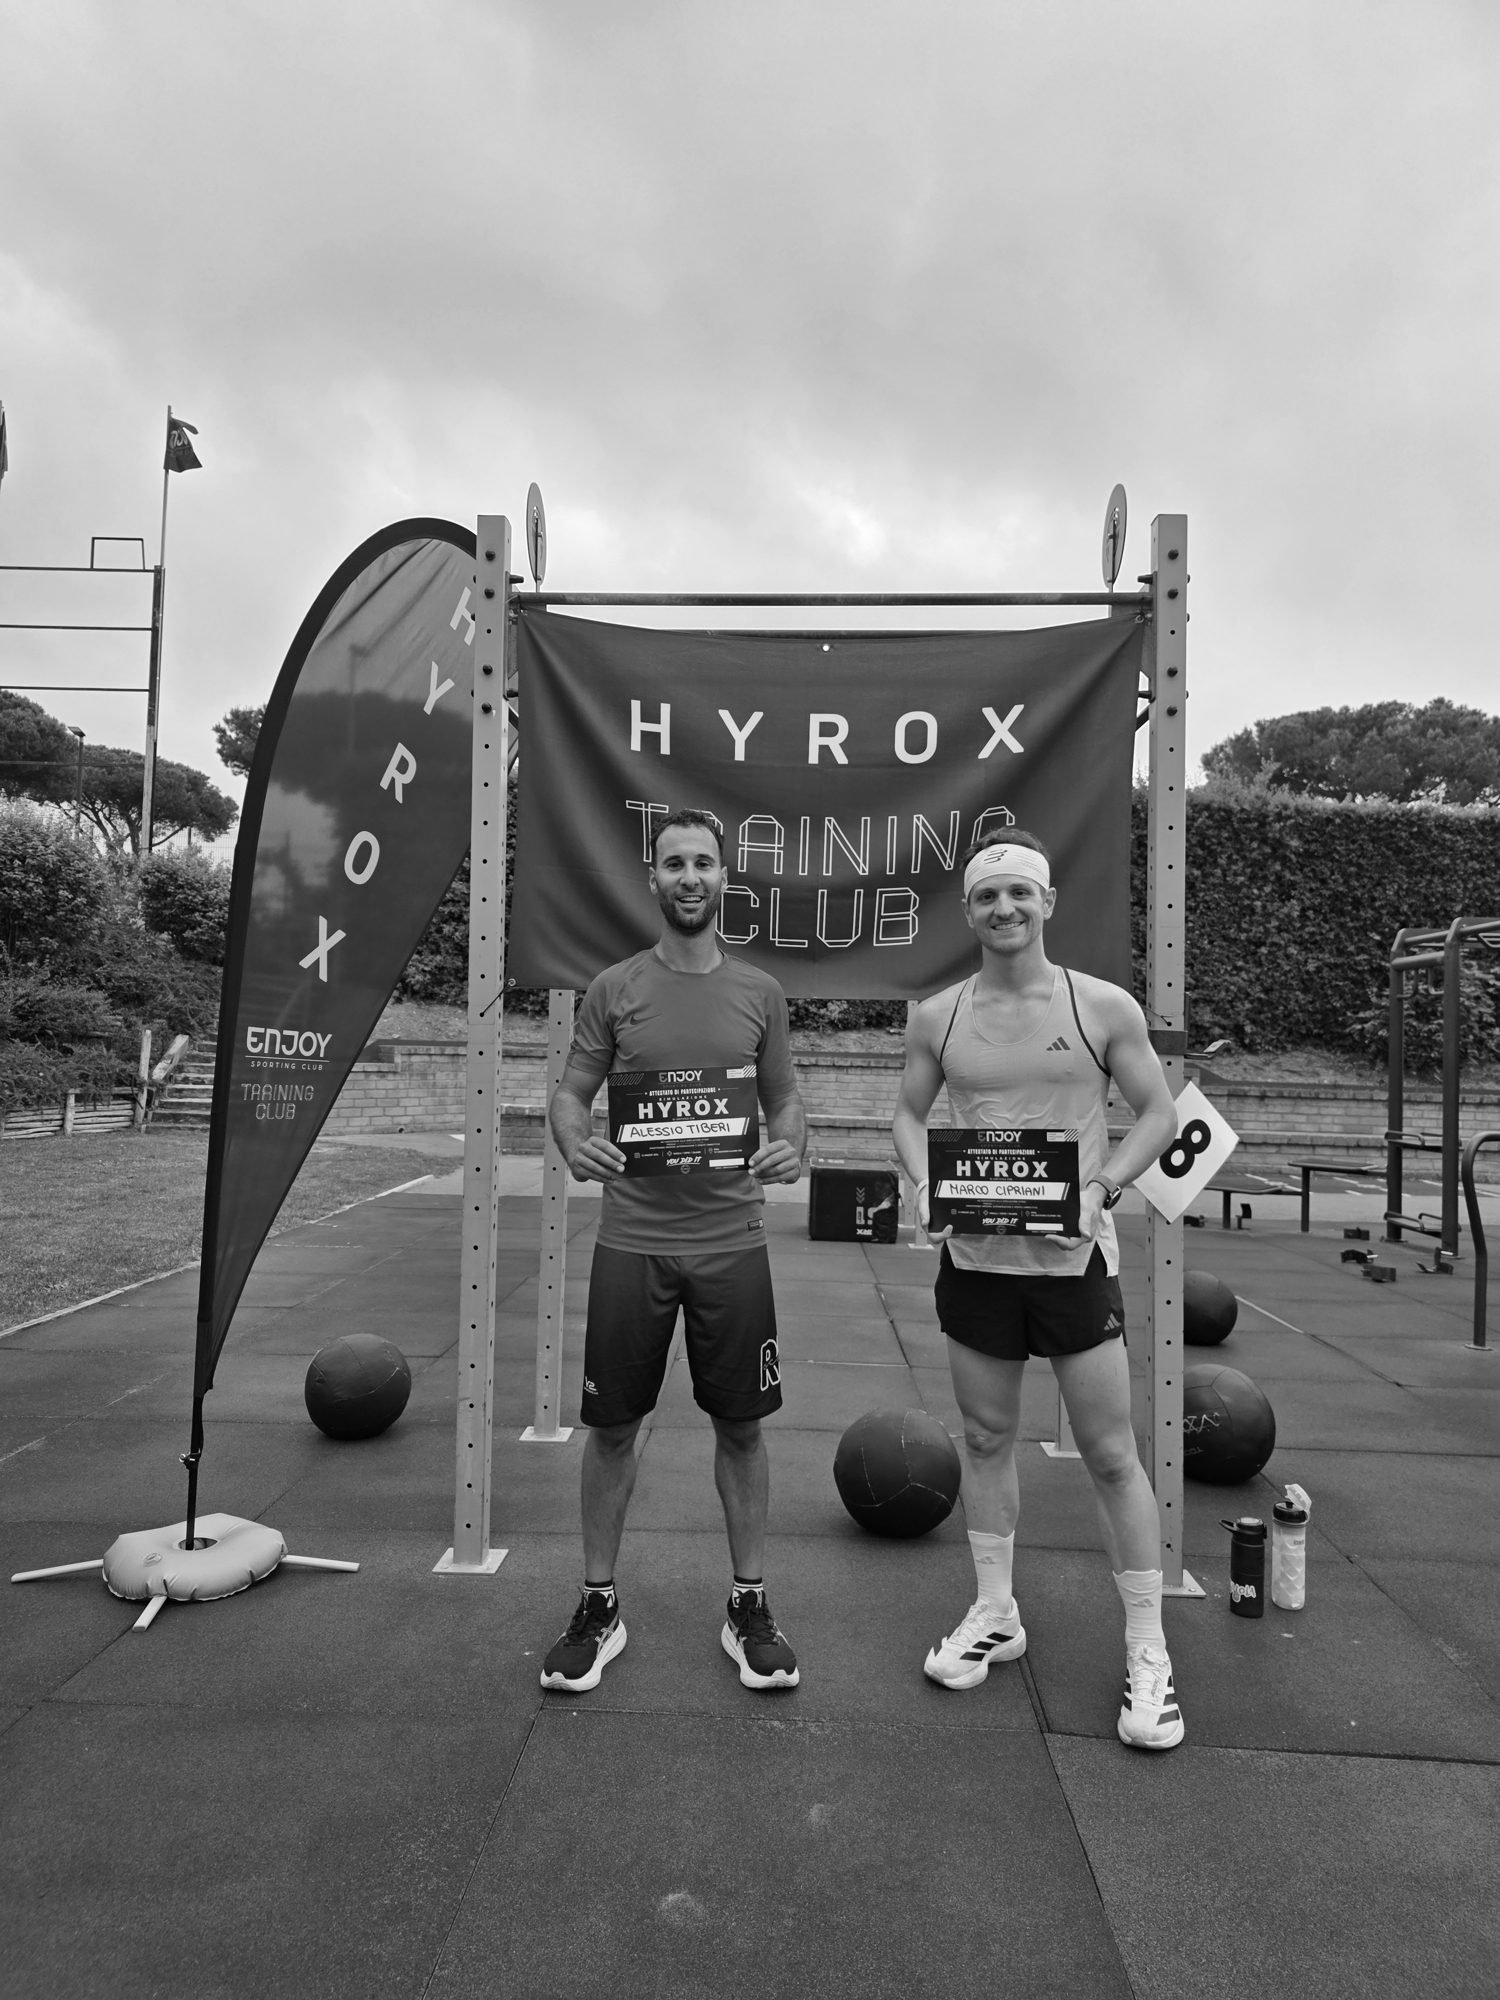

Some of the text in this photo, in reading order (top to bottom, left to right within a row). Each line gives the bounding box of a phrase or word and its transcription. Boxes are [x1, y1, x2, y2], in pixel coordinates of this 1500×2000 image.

[630, 699, 1025, 764] HYROX
[299, 586, 476, 983] HYROX
[714, 885, 920, 947] CLUB
[250, 1060, 324, 1071] SPORTING CLUB
[241, 1083, 315, 1101] TRAINING
[255, 1102, 297, 1120] CLUB
[638, 1098, 729, 1120] HYROX
[630, 1122, 730, 1138] ALESSIO TIBERI
[1159, 1119, 1211, 1179] 8
[956, 1160, 1049, 1178] HYROX
[995, 1185, 1045, 1196] CIPRIANI
